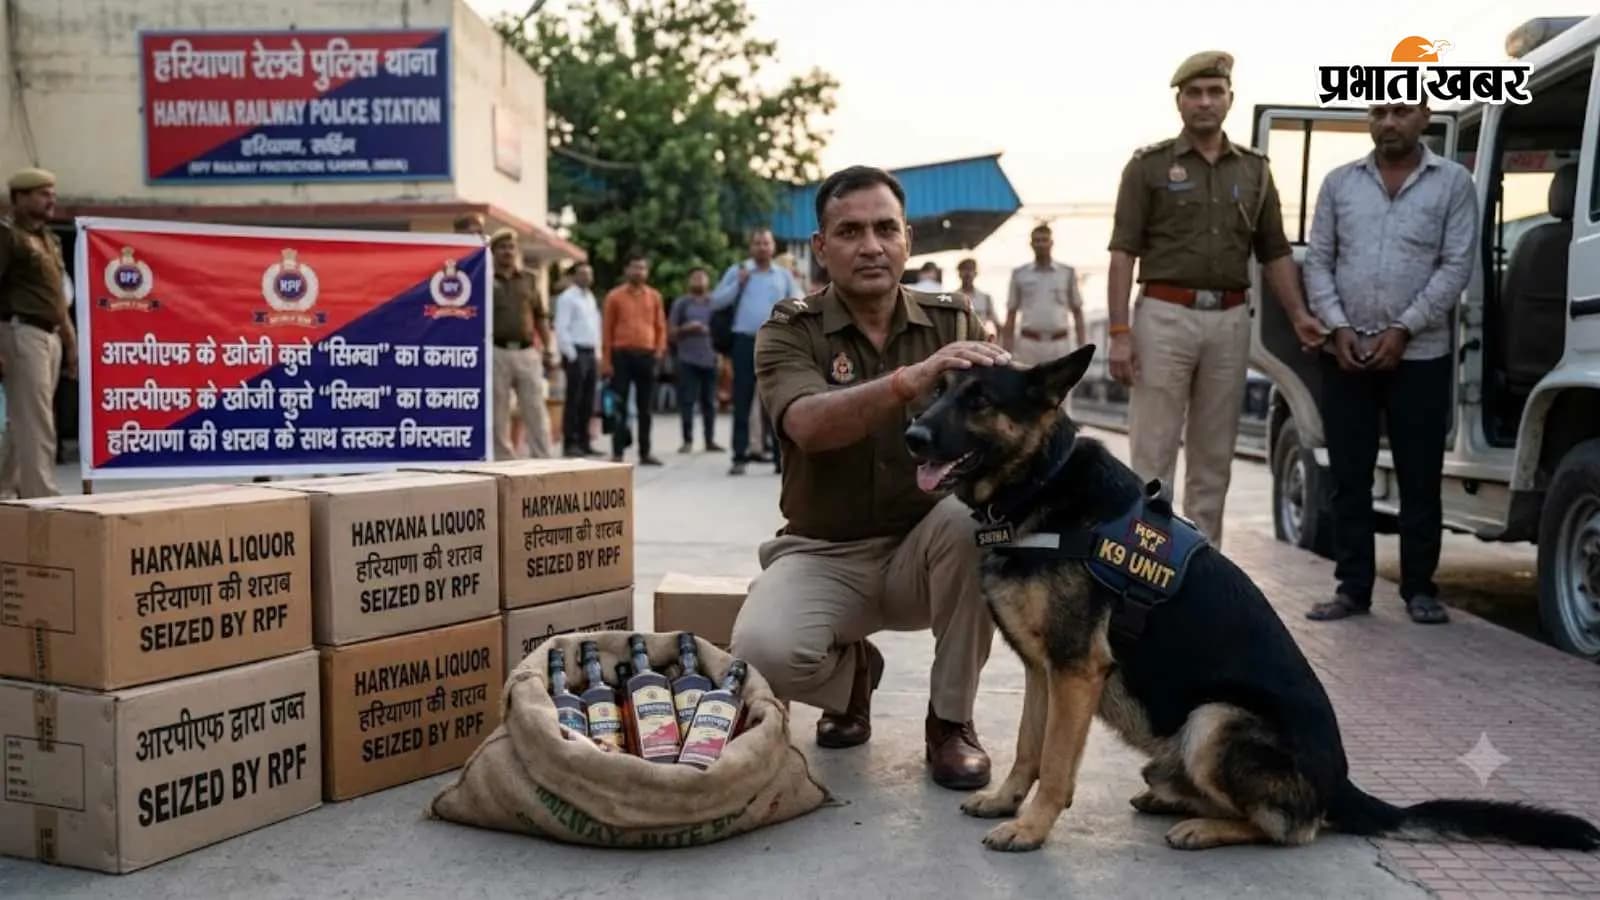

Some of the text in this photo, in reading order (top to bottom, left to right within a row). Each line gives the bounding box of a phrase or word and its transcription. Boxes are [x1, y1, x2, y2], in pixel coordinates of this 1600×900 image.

[153, 38, 437, 92] हरियाणा रेलवे पुलिस थाना
[153, 97, 440, 126] HARYANA RAILWAY POLICE STATION
[101, 332, 191, 366] आरपीएफ
[196, 335, 216, 365] के
[222, 335, 273, 366] खोजी
[394, 345, 420, 367] का
[423, 345, 479, 368] कमाल
[101, 378, 192, 411] आरपीएफ
[196, 380, 218, 410] के
[221, 379, 275, 411] खोजी
[396, 388, 422, 410] का
[425, 388, 480, 410] कमाल
[106, 420, 184, 455] हरियाणा
[189, 420, 217, 451] की
[222, 428, 270, 452] शराब
[274, 421, 296, 450] के
[300, 428, 338, 450] साथ
[340, 427, 396, 449] तस्कर
[522, 488, 625, 518] HARYANA LIQUOR
[352, 508, 485, 547] HARYANA LIQUOR
[576, 518, 592, 542] की
[131, 531, 295, 576] HARYANA LIQUOR
[355, 552, 418, 583] हरियाणा
[422, 543, 443, 570] की
[527, 545, 620, 578] SEIZED BY RPF
[1098, 538, 1176, 589] K9 UNIT
[135, 571, 292, 617] हरियाणा की शराब
[360, 572, 480, 613] SEIZED BY RPF
[140, 604, 288, 652] SEIZED BY RPF
[354, 647, 491, 697] HARYANA LIQUOR
[358, 698, 423, 732] हरियाणा
[426, 685, 446, 713] की
[136, 707, 224, 762] आरपीएफ
[228, 702, 266, 742] द्वारा
[362, 711, 484, 763] SEIZED BY RPF
[138, 742, 306, 827] SEIZED BY RPF
